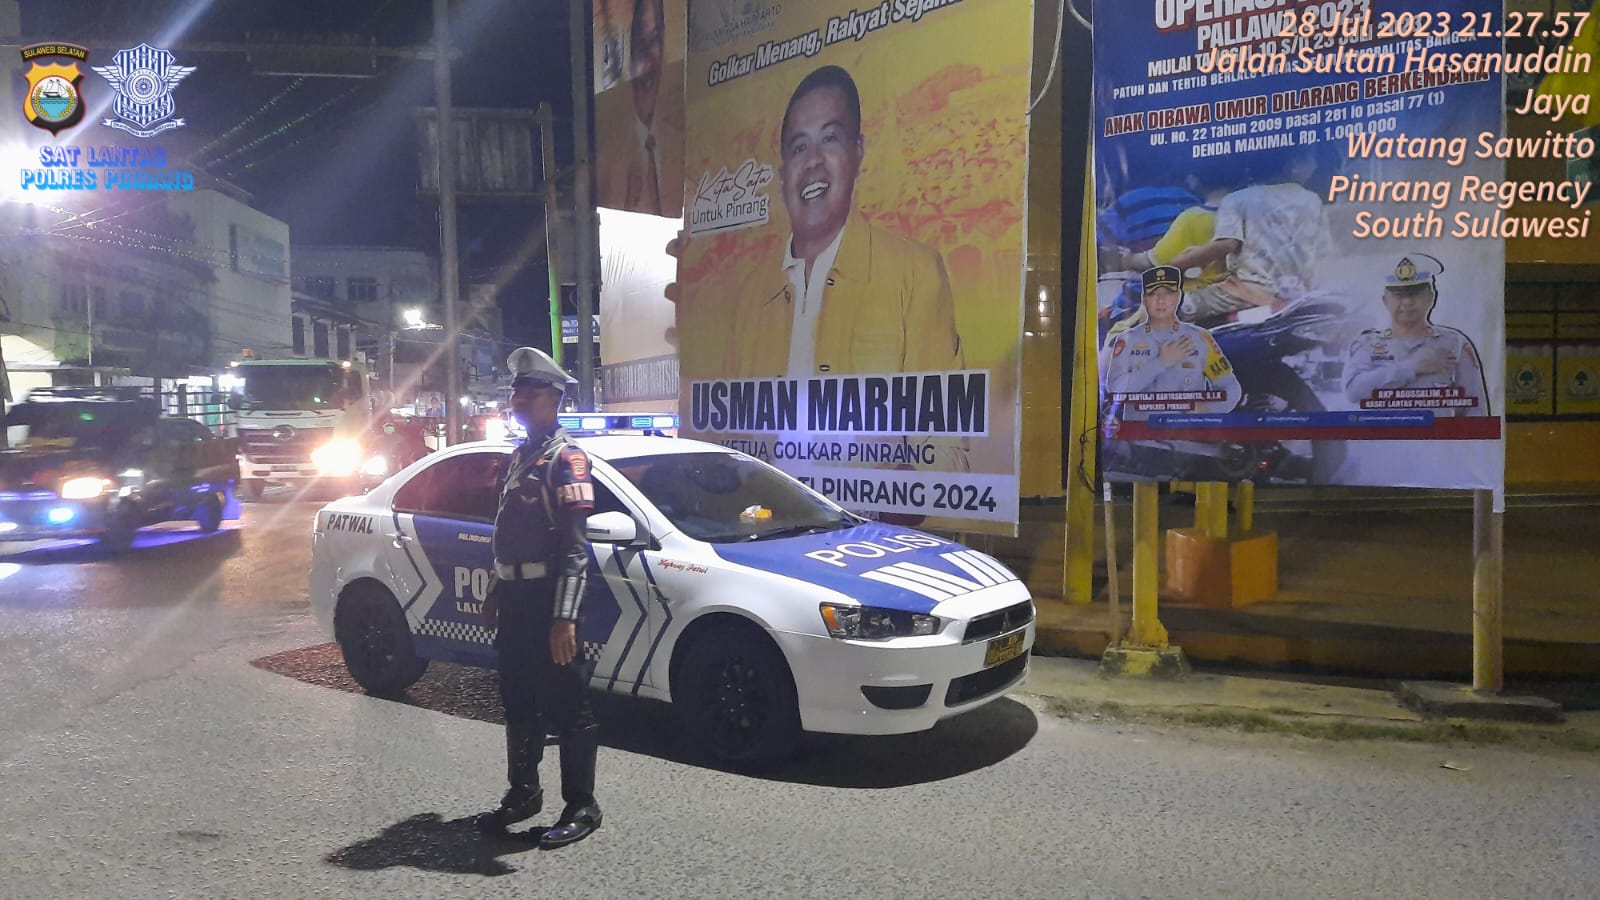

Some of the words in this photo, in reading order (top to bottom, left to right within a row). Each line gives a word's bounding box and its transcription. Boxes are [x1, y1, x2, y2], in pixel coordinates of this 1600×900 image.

[708, 53, 755, 87] Golkar
[755, 28, 823, 71] Menang,
[824, 0, 890, 45] Rakyat
[1148, 55, 1191, 77] MULAI
[1113, 84, 1145, 99] PATUH
[1148, 80, 1169, 95] DAN
[1173, 75, 1207, 91] TERTIB
[1104, 112, 1145, 137] ANAK
[1148, 102, 1212, 130] DIBAWA
[1215, 95, 1268, 121] UMUR
[1271, 81, 1360, 114] DILARANG
[1150, 133, 1167, 146] UU.
[1193, 128, 1207, 140] 22
[1211, 123, 1246, 139] Tahun
[1250, 120, 1282, 133] 2009
[1286, 112, 1321, 130] pasal
[1325, 109, 1347, 122] 281
[1367, 96, 1404, 117] pasal
[1408, 94, 1424, 110] 77
[1193, 140, 1231, 158] DENDA
[1235, 133, 1295, 153] MAXIMAL
[692, 206, 723, 225] Untuk
[726, 198, 767, 217] Pinrang
[691, 380, 798, 431] USMAN
[807, 373, 987, 433] MARHAM
[773, 441, 842, 461] GOLKAR
[847, 442, 936, 465] PINRANG
[822, 477, 925, 507] PINRANG
[932, 483, 997, 512] 2024
[326, 513, 374, 535] PATWAL
[803, 532, 953, 568] POLISI
